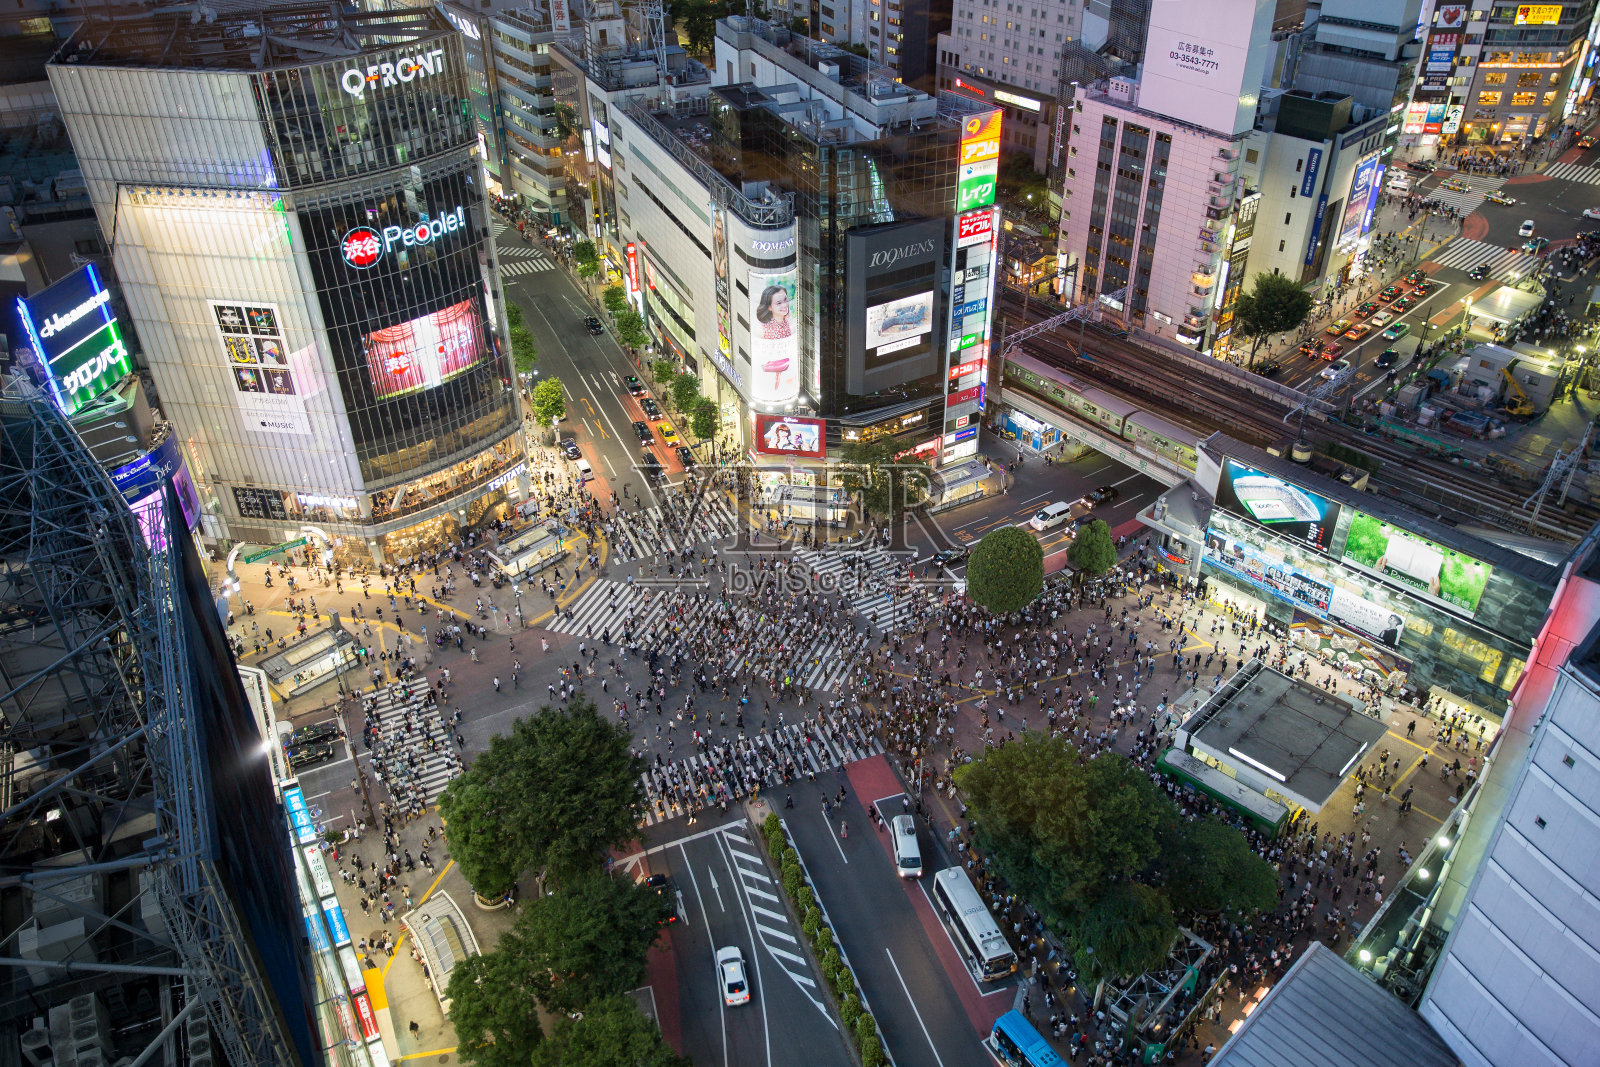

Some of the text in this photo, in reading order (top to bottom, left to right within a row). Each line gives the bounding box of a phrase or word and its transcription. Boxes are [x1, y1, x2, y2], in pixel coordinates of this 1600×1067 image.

[1178, 41, 1214, 57] 広告募集中
[1169, 51, 1219, 70] 03-3543-7771
[965, 141, 999, 160] アコム
[962, 182, 993, 202] レイク
[382, 205, 466, 253] People!
[961, 220, 990, 236] アイフル
[343, 235, 381, 261] 渋谷
[961, 336, 976, 346] レイク
[63, 339, 128, 395] サロンパス
[951, 365, 973, 377] アコム
[268, 421, 295, 429] MUSIC
[155, 460, 173, 480] DHC
[487, 463, 527, 492] TSUTAYA
[1390, 570, 1430, 592] Paperwhi
